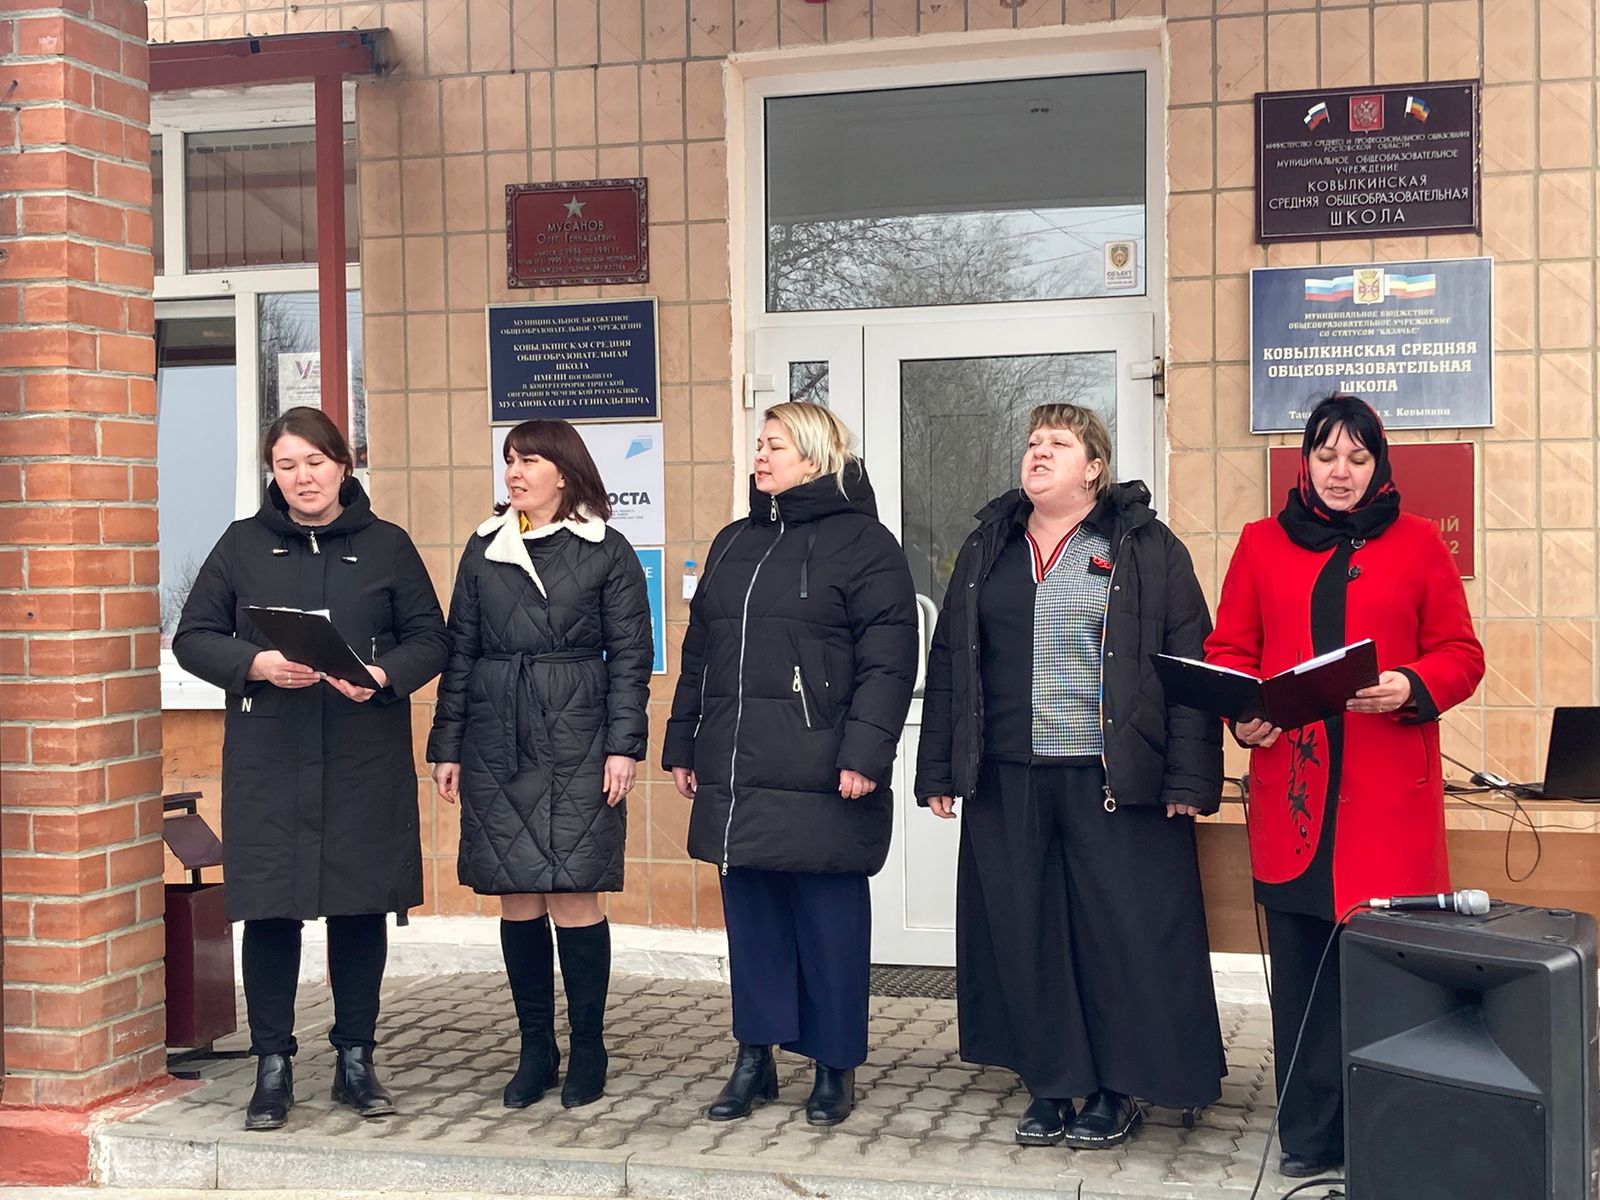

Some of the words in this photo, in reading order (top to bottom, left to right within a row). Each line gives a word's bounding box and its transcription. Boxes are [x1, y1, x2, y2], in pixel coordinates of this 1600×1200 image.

[1377, 142, 1410, 150] ОБЛАСТИ
[1276, 156, 1349, 168] МУНИЦИПАЛЬНОЕ
[1355, 149, 1458, 163] ОБЩЕОБРАЗОВАТЕЛЬНОЕ
[1335, 163, 1398, 175] УЧРЕЖДЕНИЕ
[1307, 174, 1427, 193] КОВЫЛКИНСКАЯ
[1269, 195, 1319, 210] СРЕДНЯЯ
[1325, 187, 1469, 207] ОБЩЕОБРАЗОВАТЕЛЬНАЯ
[1330, 208, 1405, 227] ШКОЛА
[547, 220, 605, 232] МУСАНОВ
[1304, 310, 1378, 320] МУНИЦИПАЛЬНОЕ
[1380, 308, 1435, 318] БЮДЖЕТНОЕ
[1288, 319, 1391, 330] ОБЩЕОБРАЗОВАТЕЛЬНОЕ
[1393, 317, 1451, 327] УЧРЕЖДЕНИЕ
[1319, 330, 1330, 338] СО
[1332, 328, 1375, 337] СТАТУСОМ
[513, 342, 588, 352] КОВЫЛКИНСКАЯ
[590, 340, 631, 349] СРЕДНЯЯ
[1263, 344, 1397, 361] КОВЫЛКИНСКАЯ
[1401, 341, 1477, 357] СРЕДНЯЯ
[517, 350, 629, 362] ОБЩЕОБРАЗОВАТЕЛЬНАЯ
[556, 362, 589, 371] ШКОЛА
[1268, 359, 1472, 378] ОБЩЕОБРАЗОВАТЕЛЬНАЯ
[533, 373, 567, 381] ИМЕНИ
[1340, 379, 1398, 393] ШКОЛА
[498, 398, 548, 409] МУСАНОВА
[549, 397, 577, 407] ОЛЕГА
[578, 396, 650, 407] ГЕННАДЬЕВИЧА
[607, 491, 651, 506] ОСТА
